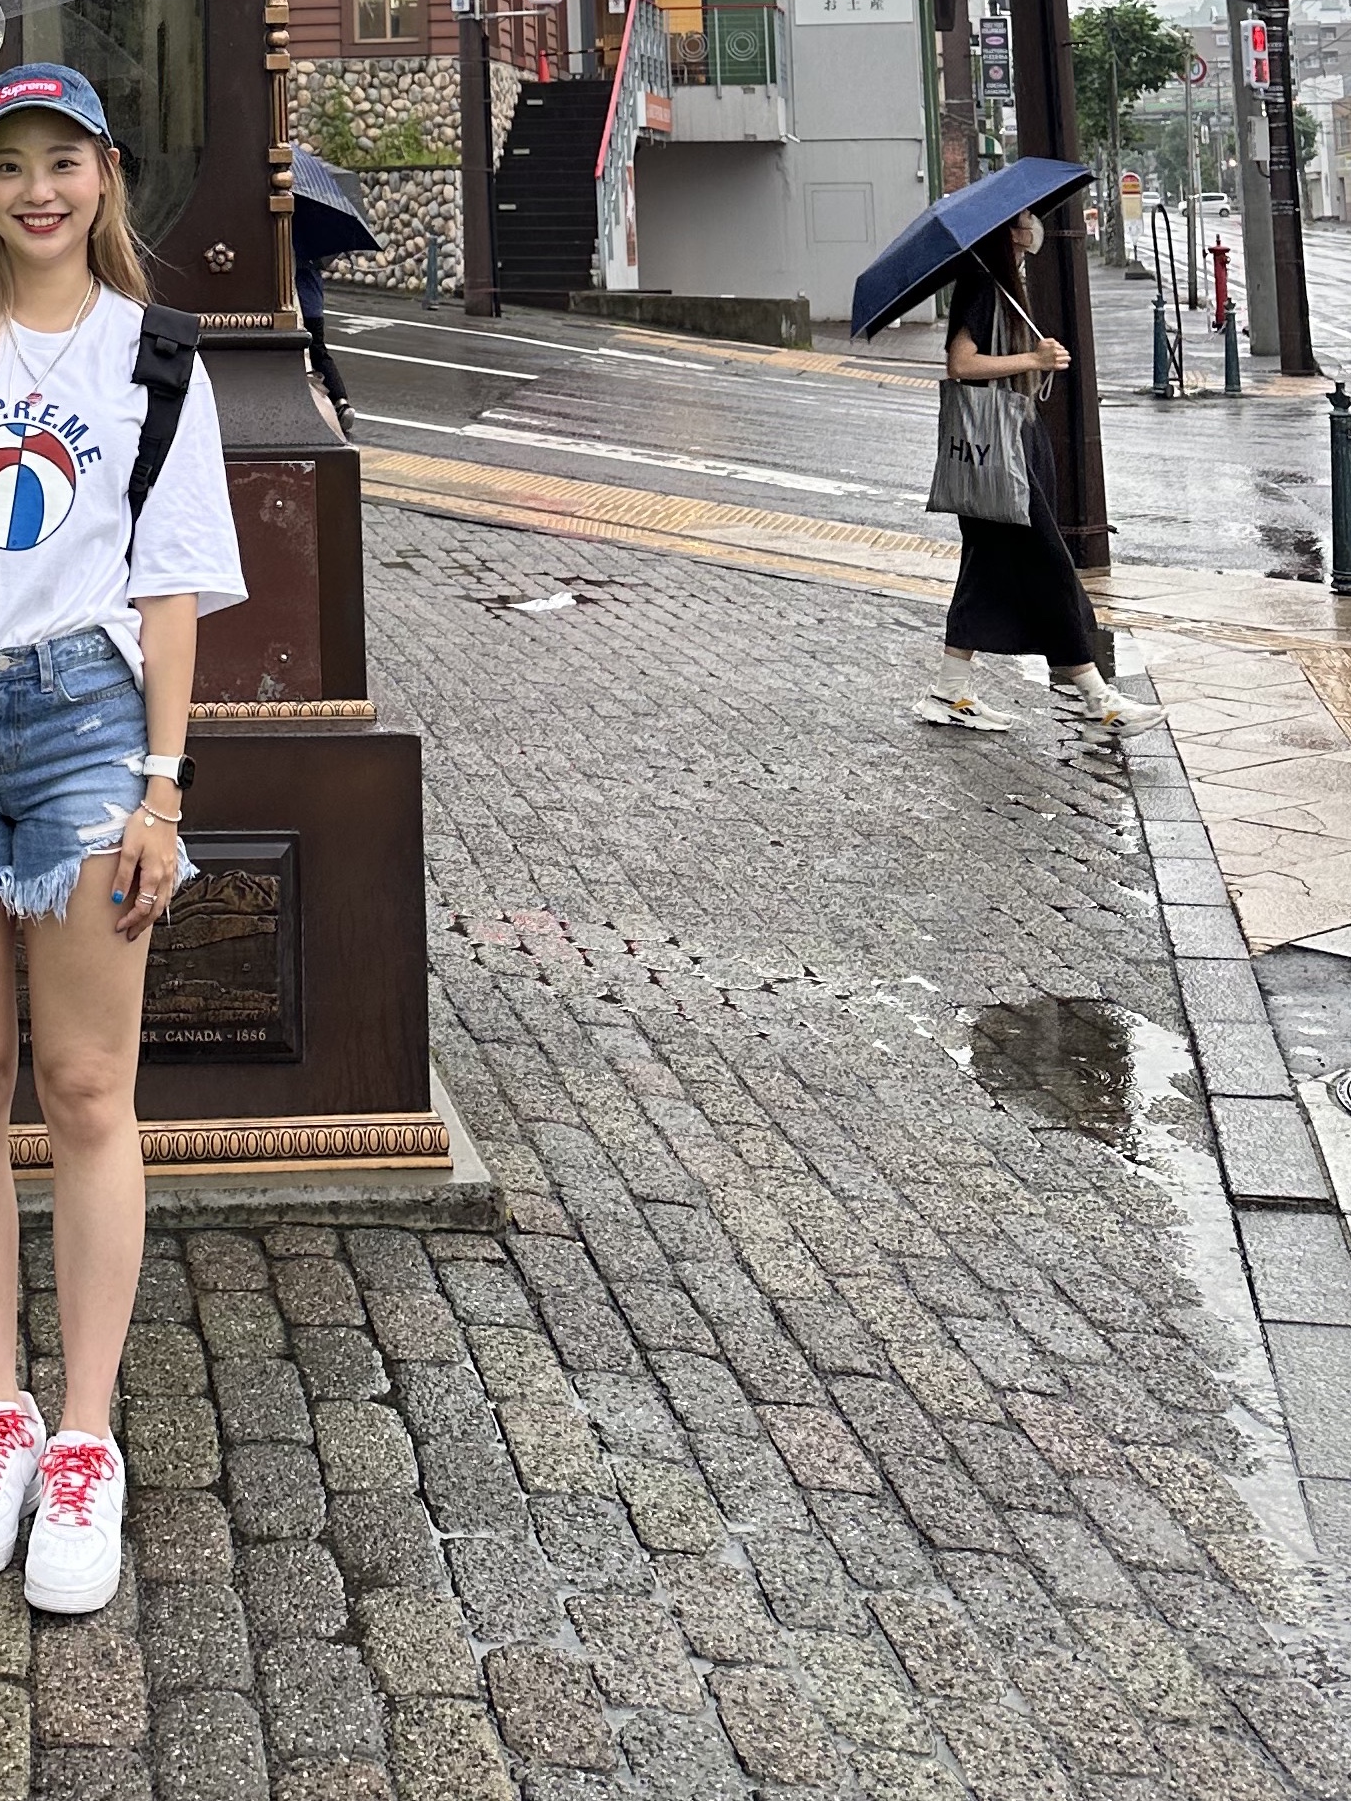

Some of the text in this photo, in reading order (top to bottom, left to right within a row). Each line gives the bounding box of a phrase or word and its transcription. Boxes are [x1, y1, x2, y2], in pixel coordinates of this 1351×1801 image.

[0, 82, 57, 99] Supreme
[165, 1030, 223, 1042] CANADA
[236, 1028, 267, 1042] 1886
